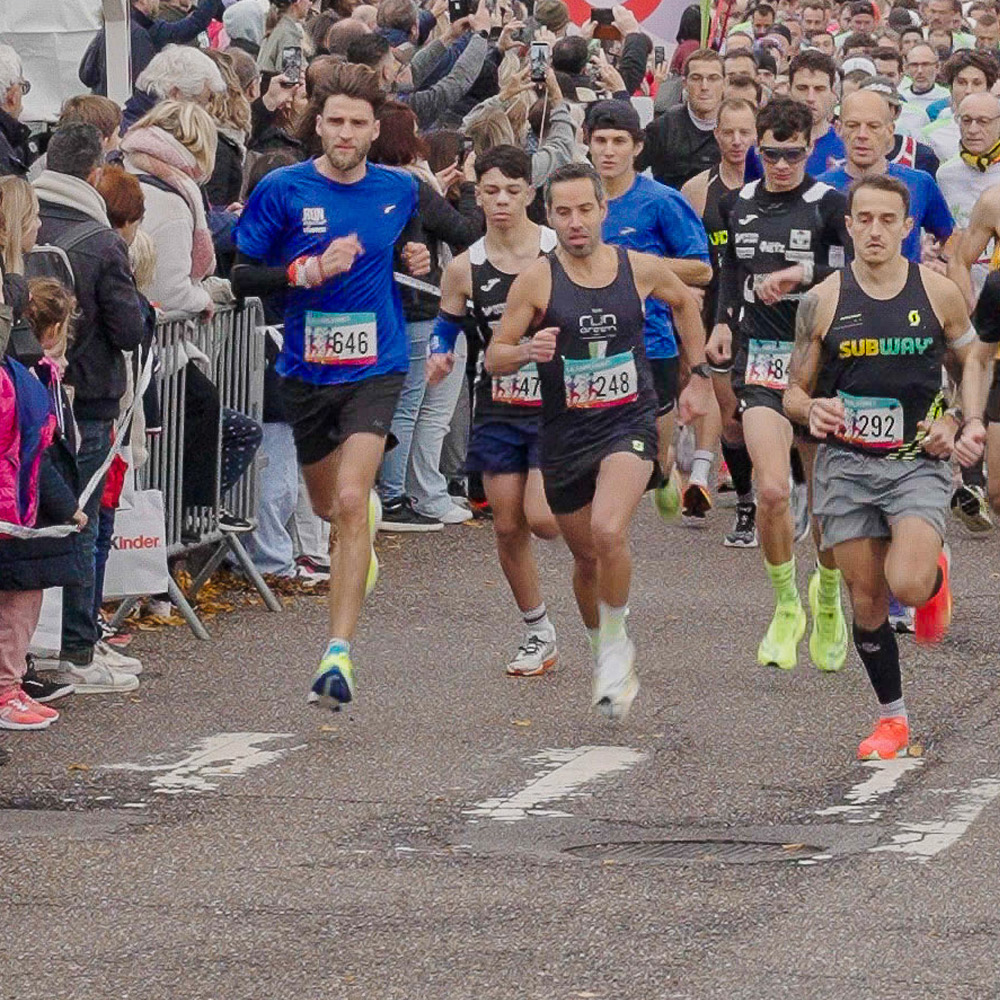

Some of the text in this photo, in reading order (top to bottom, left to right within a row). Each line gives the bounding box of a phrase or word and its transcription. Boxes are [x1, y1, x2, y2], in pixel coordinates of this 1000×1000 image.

[333, 331, 368, 354] 646
[838, 337, 930, 358] SUBWAY
[774, 358, 789, 380] 8
[596, 371, 630, 397] 248
[858, 415, 894, 439] 292
[111, 534, 159, 550] Kinder
